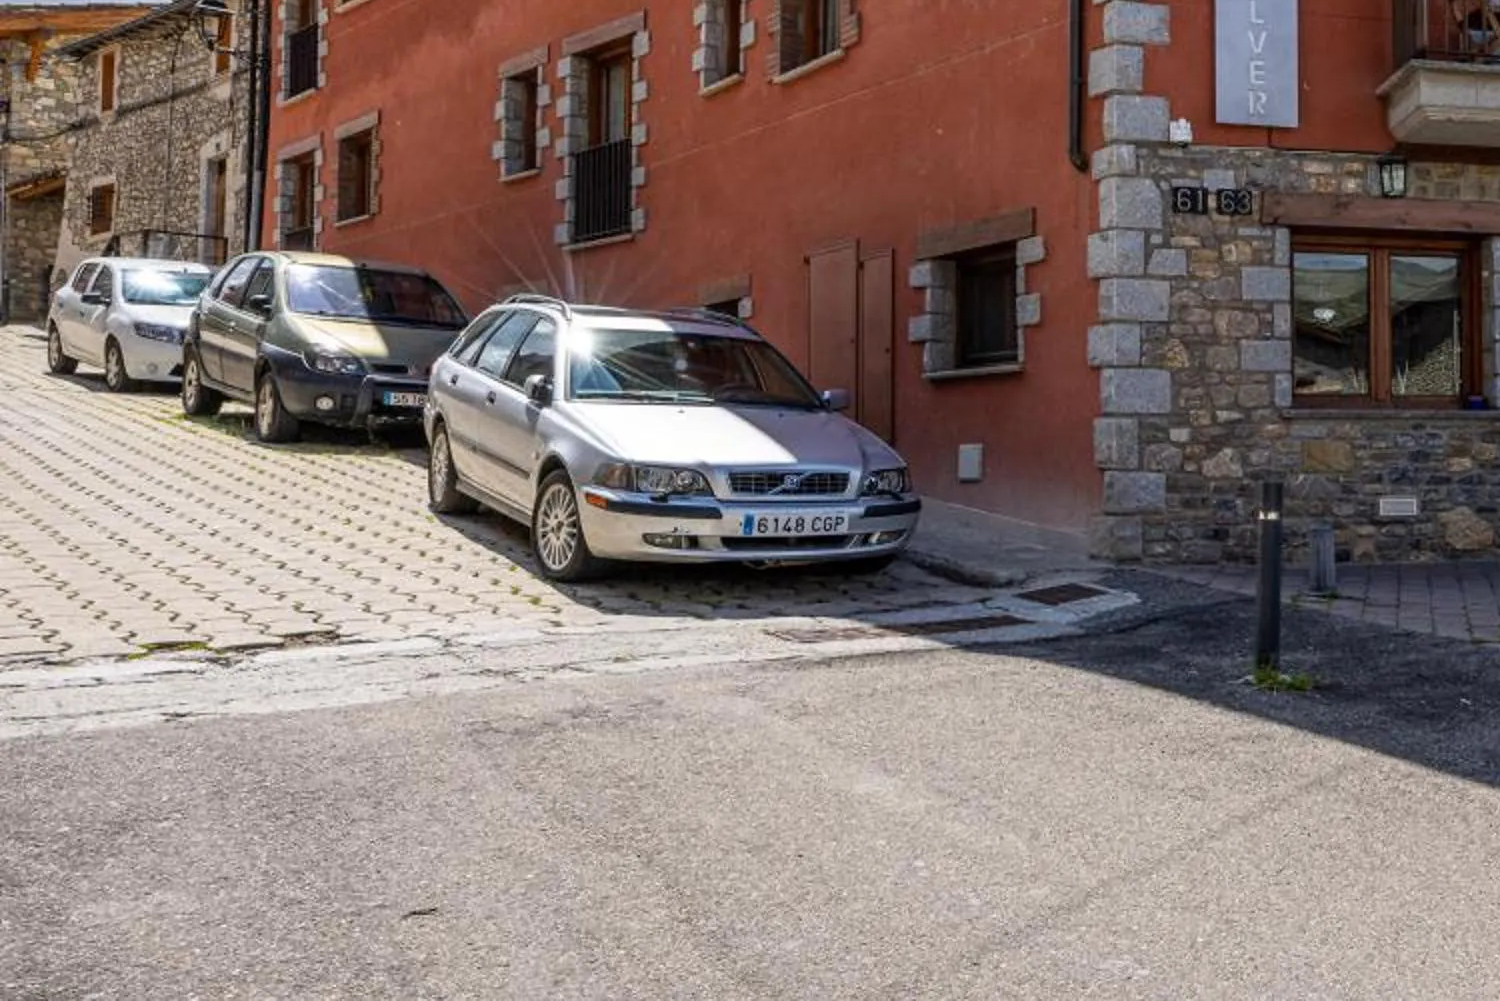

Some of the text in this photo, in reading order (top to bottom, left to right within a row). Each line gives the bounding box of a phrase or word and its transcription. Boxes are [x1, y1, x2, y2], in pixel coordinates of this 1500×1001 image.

[1177, 188, 1203, 212] 61
[758, 516, 845, 533] 6148 CGP
